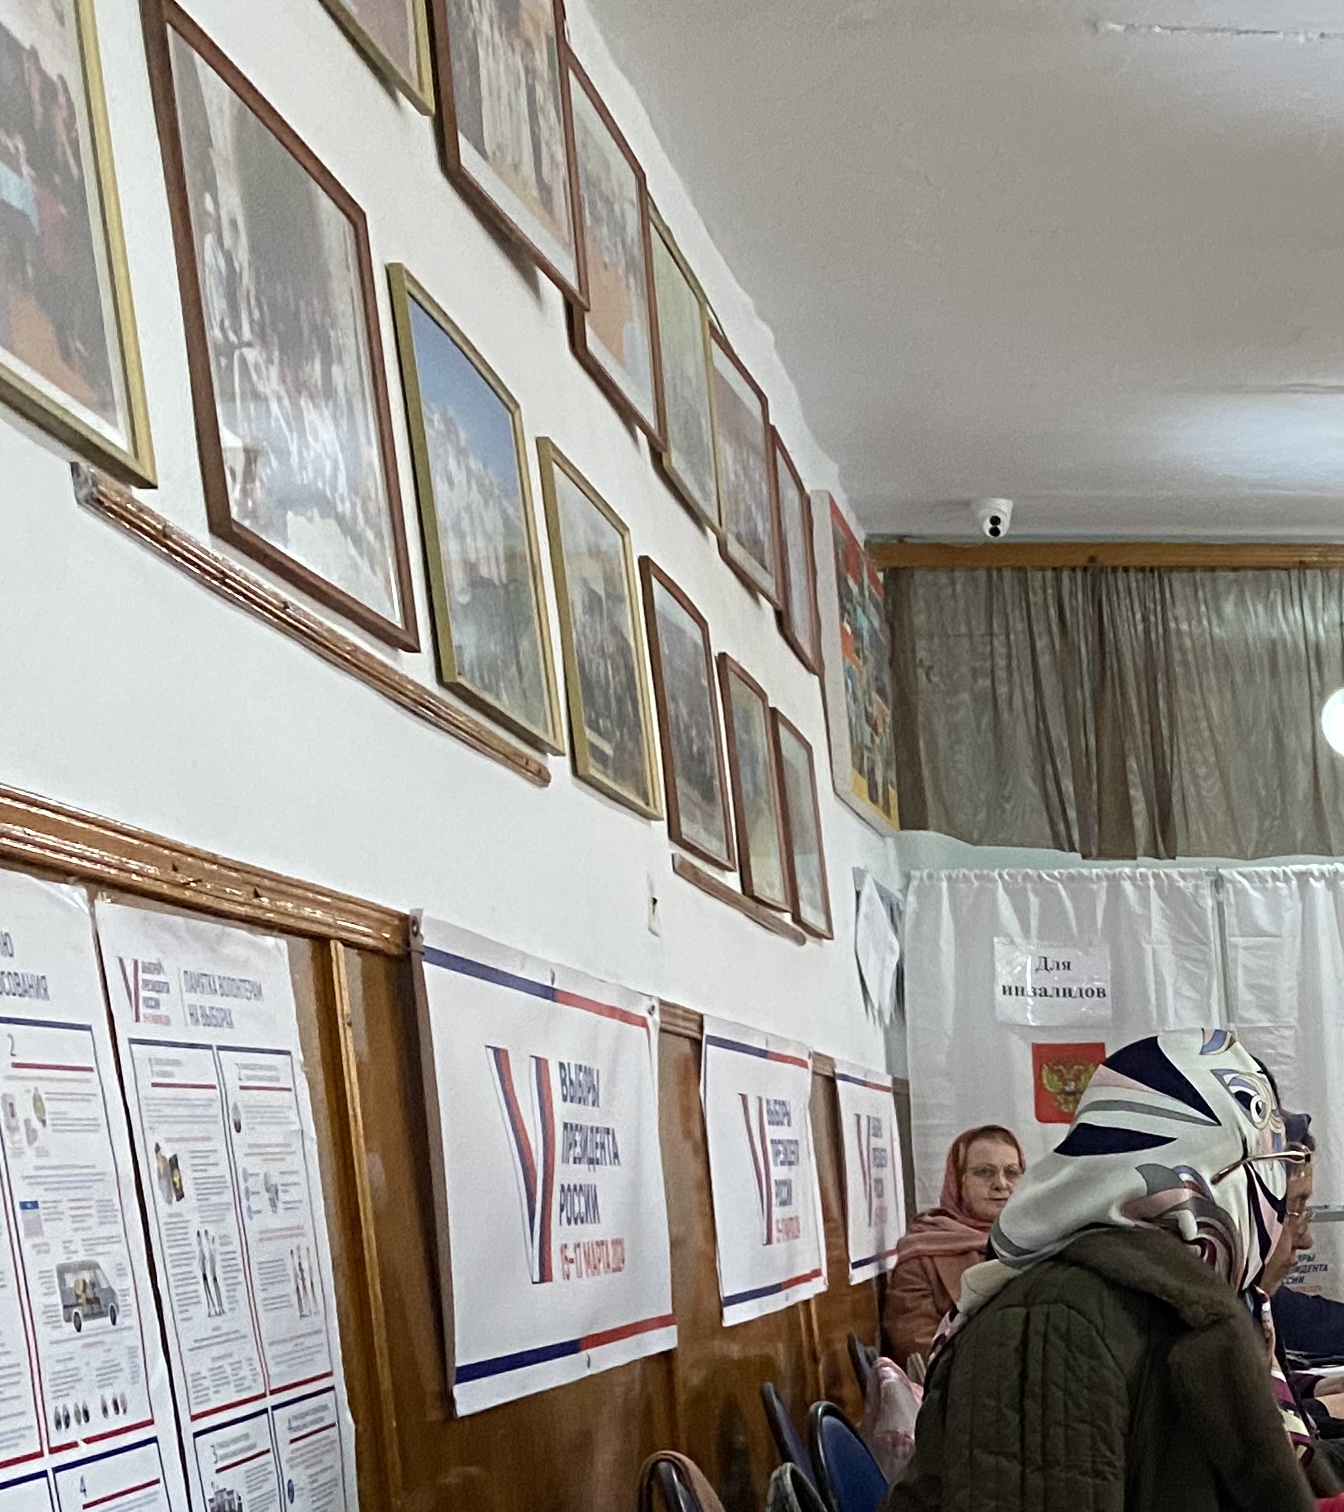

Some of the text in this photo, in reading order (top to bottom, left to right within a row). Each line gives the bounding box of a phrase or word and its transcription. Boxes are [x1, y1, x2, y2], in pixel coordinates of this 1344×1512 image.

[0, 970, 50, 1001] СОВАНИЯ
[1035, 956, 1071, 974] Для
[558, 1061, 601, 1108] ВЫБОРЫ
[561, 1121, 621, 1172] ПРЕЗИДЕНТА
[559, 1183, 601, 1227] РОССИИ
